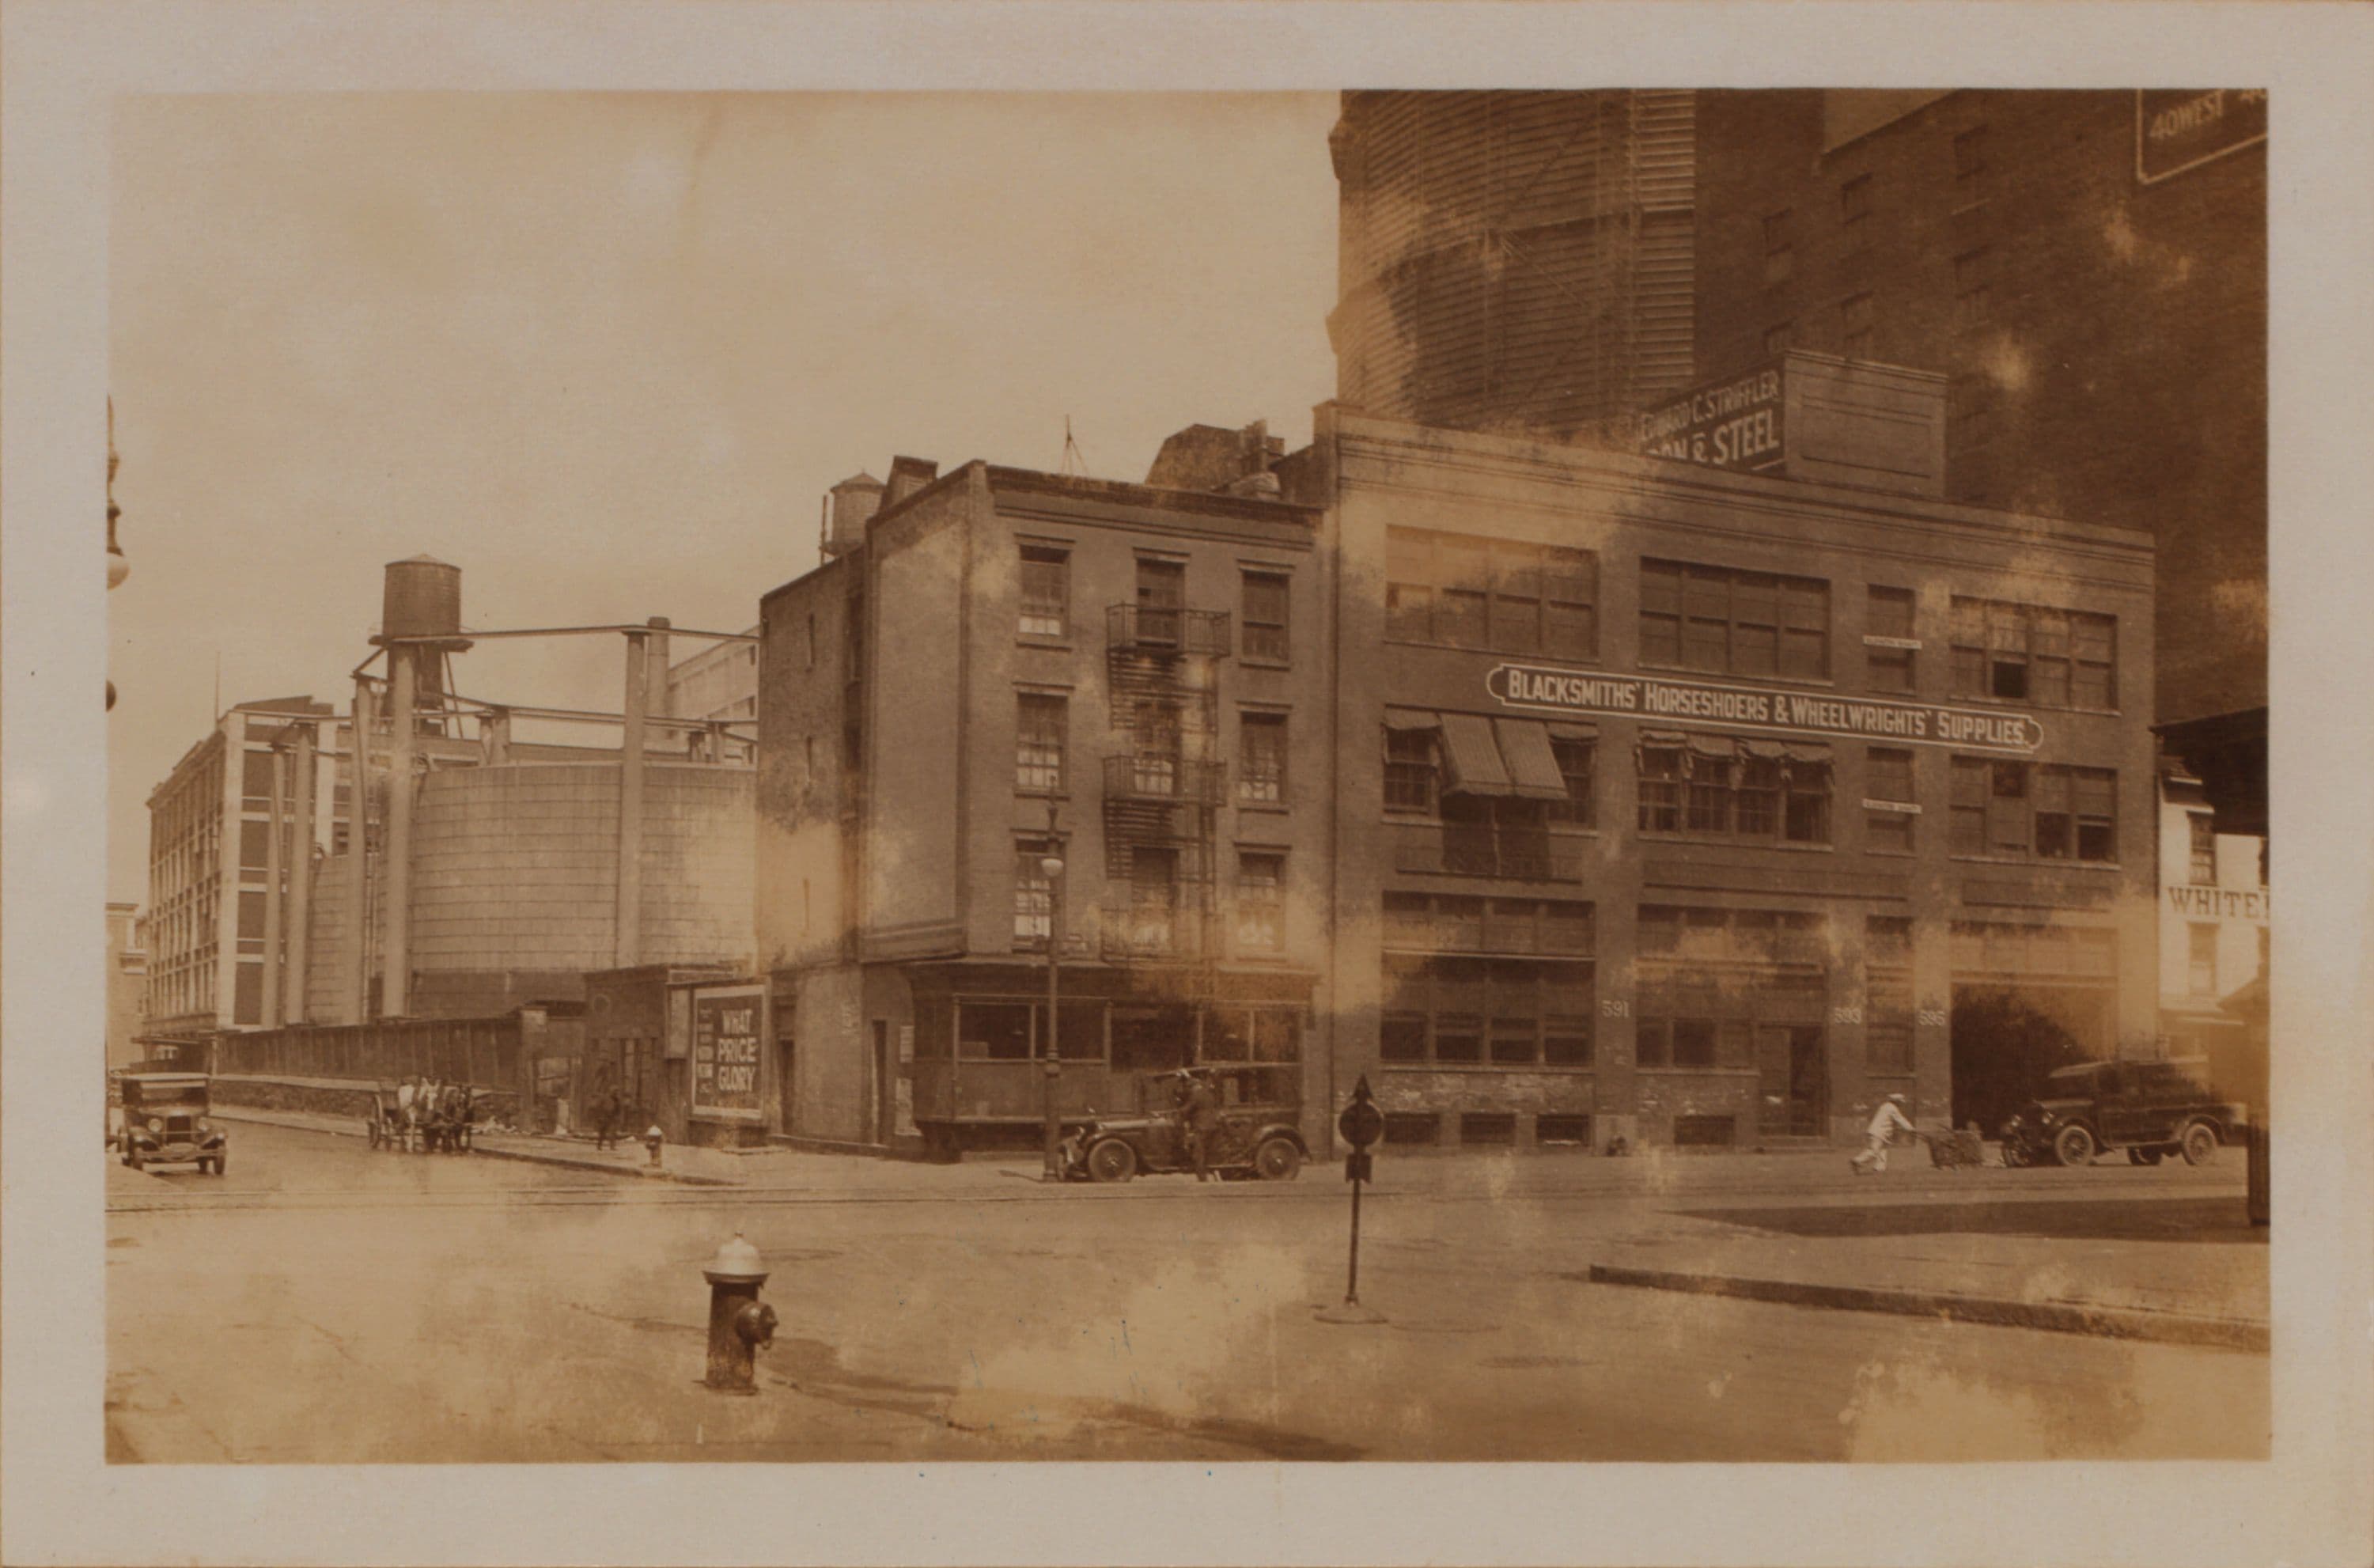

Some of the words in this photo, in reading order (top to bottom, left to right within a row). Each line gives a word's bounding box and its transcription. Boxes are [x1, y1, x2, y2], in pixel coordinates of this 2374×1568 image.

[1712, 408, 1780, 465] STEEL
[1509, 670, 1641, 710] BLACKSMITHS'
[1645, 683, 1768, 722] HORSESHOERS
[1774, 695, 1789, 723] &
[721, 1009, 753, 1035] WHAT
[1601, 1000, 1630, 1019] 591
[1834, 1006, 1862, 1025] 593
[717, 1037, 757, 1063] PRICE
[718, 1065, 755, 1092] GLORY
